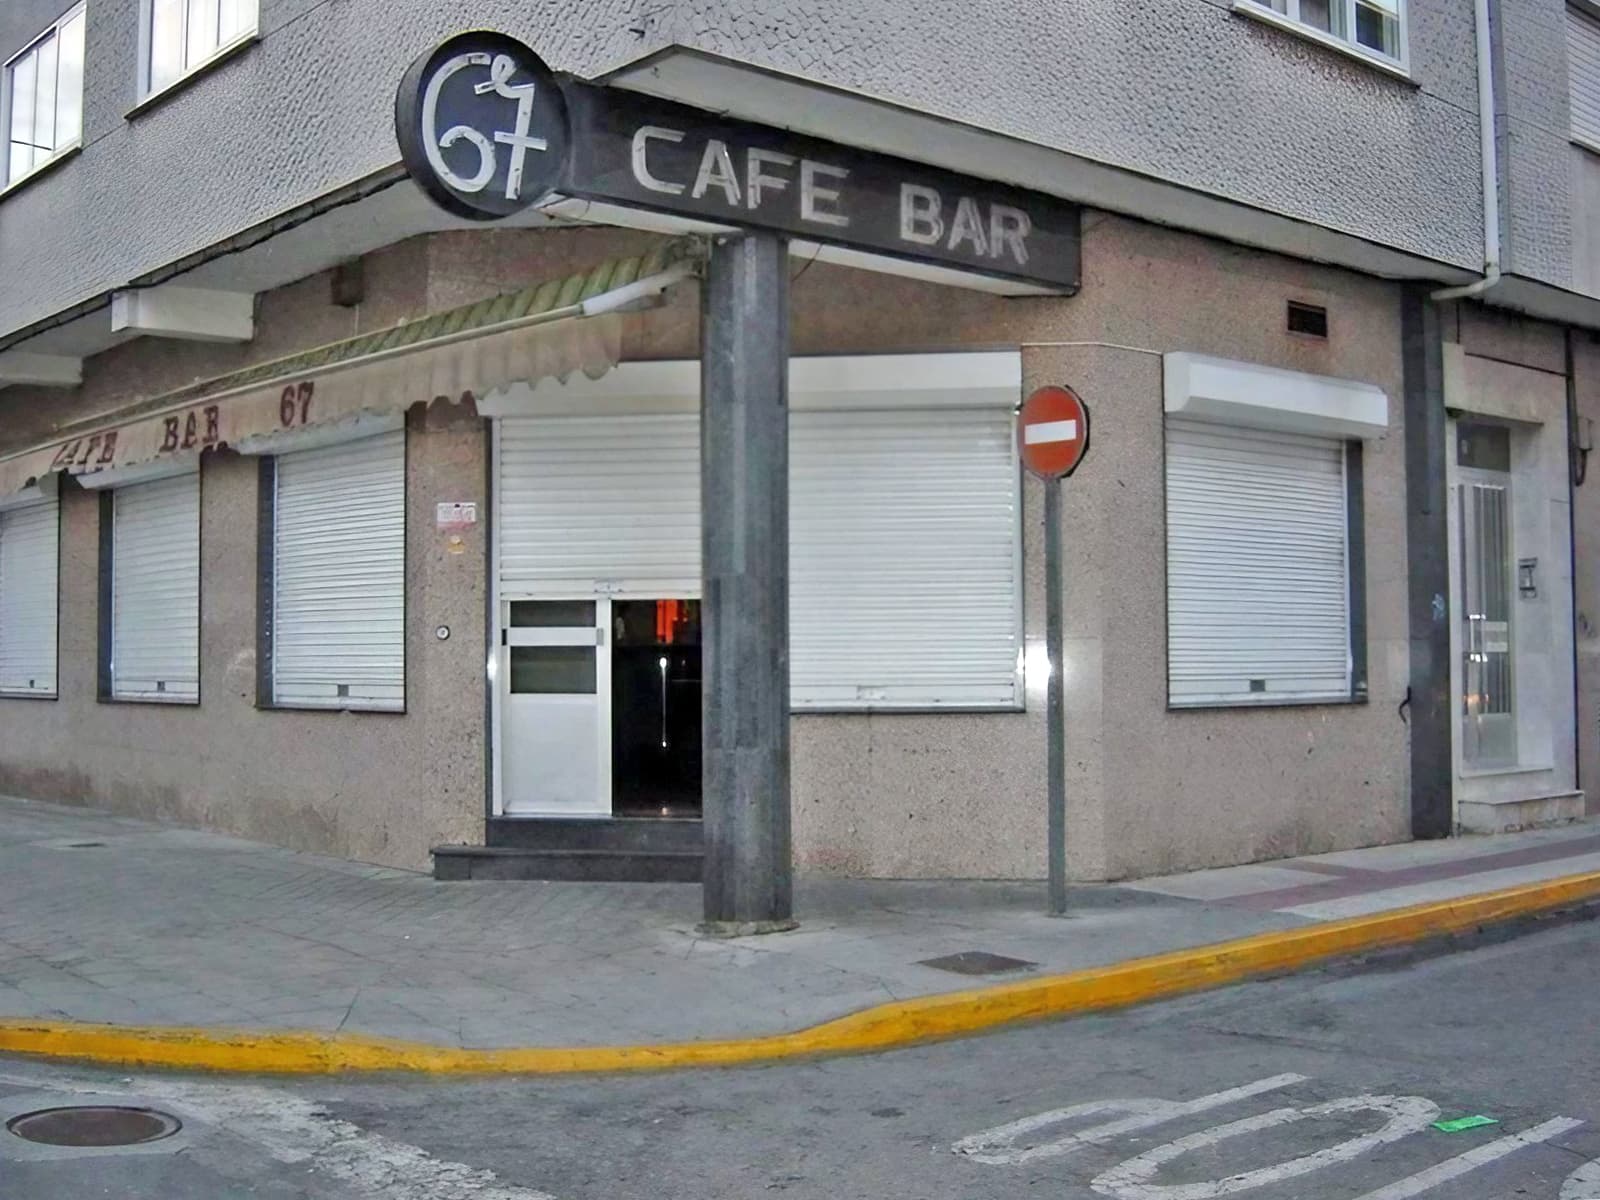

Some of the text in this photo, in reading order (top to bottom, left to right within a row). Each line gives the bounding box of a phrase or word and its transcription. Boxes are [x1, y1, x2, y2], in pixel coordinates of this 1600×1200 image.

[423, 51, 547, 201] 67
[631, 125, 1032, 265] CAFE BAR
[160, 406, 220, 453] BAR
[280, 382, 315, 427] 67
